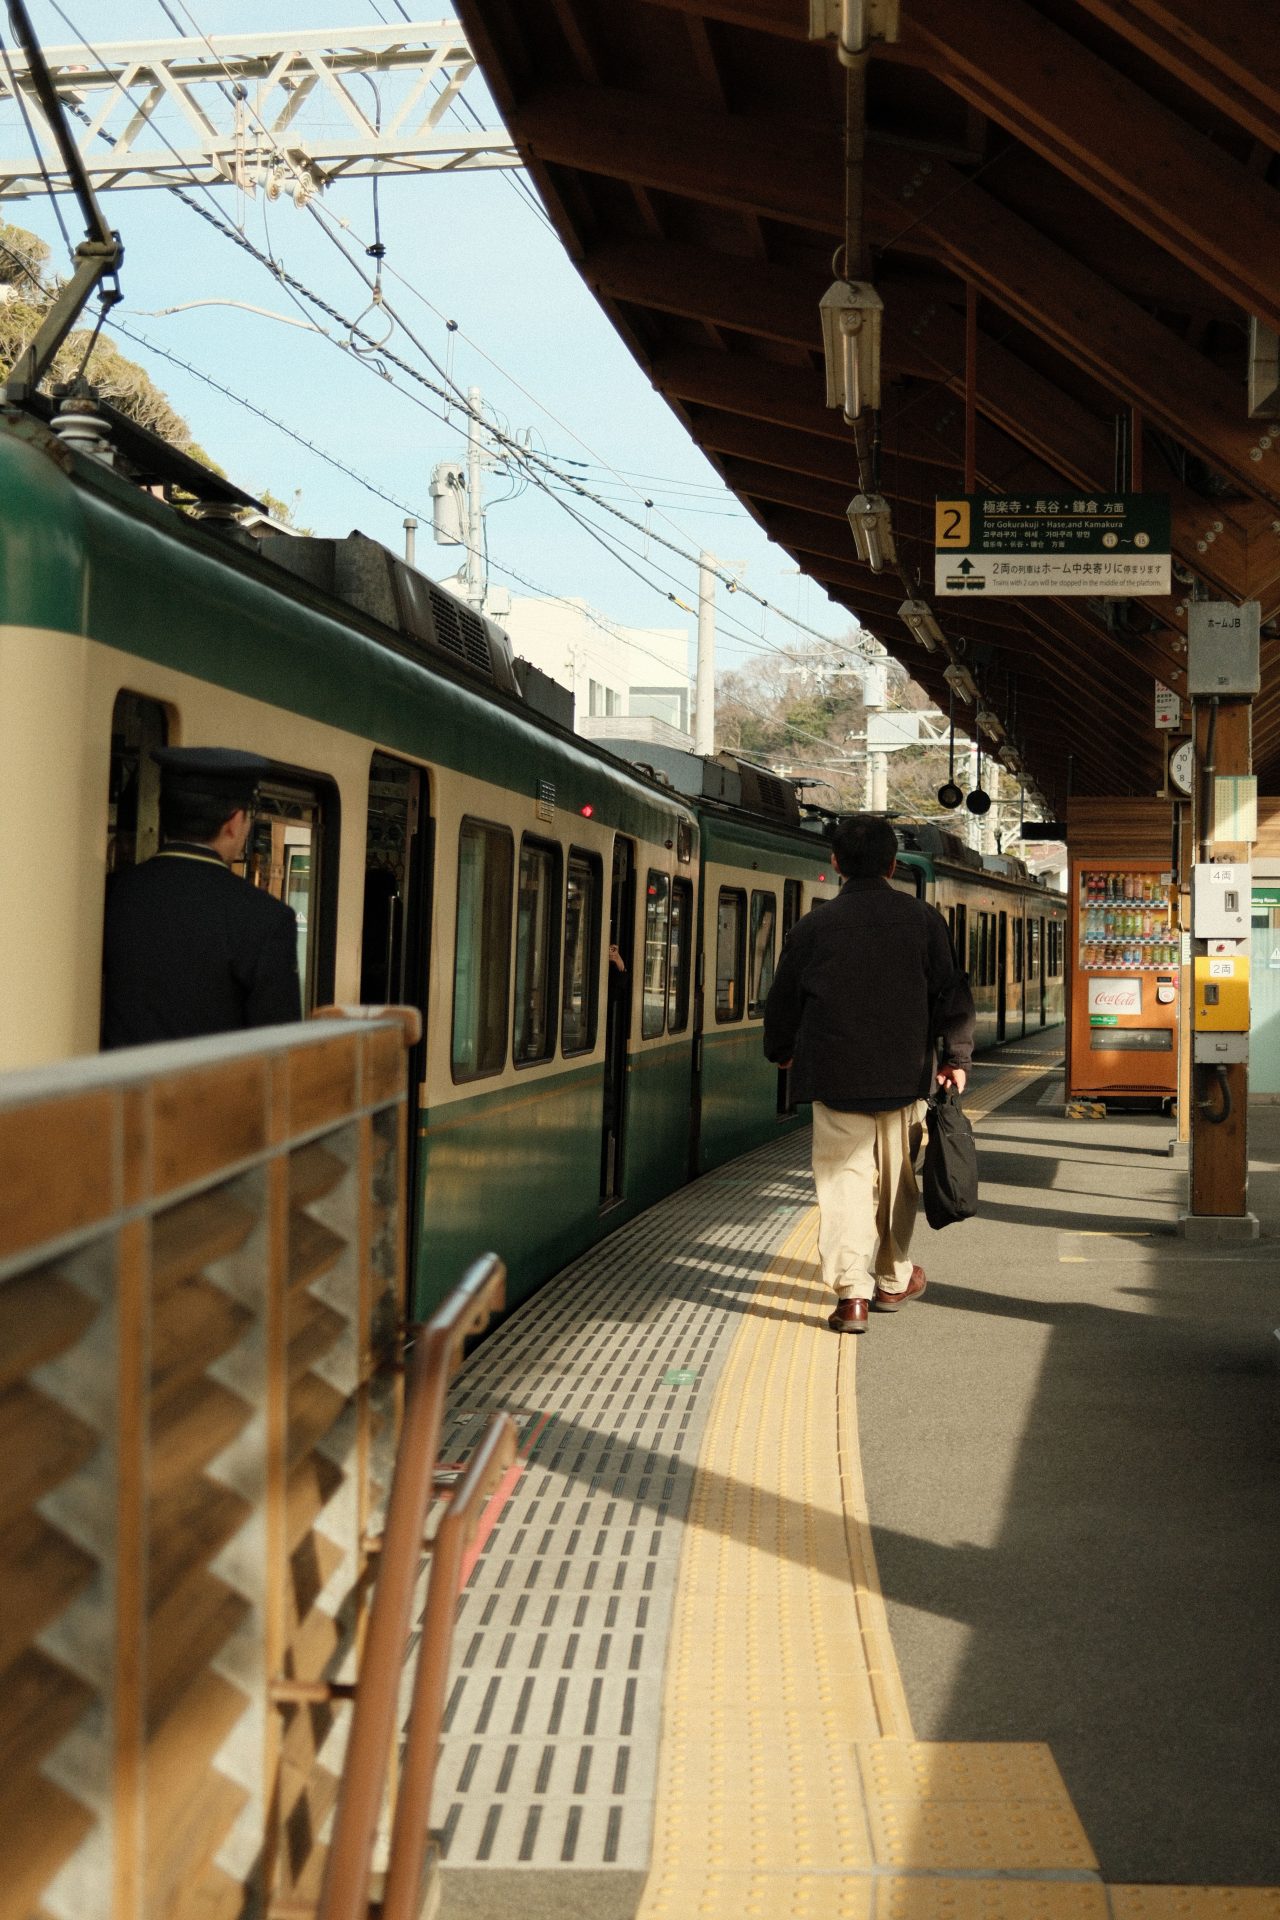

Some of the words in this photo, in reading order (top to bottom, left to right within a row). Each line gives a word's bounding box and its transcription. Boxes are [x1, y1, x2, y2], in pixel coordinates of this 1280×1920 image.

[983, 500, 1098, 514] 極楽寺・長谷・鎌倉
[1103, 502, 1124, 514] 方面
[943, 509, 961, 539] 2
[984, 521, 995, 529] for
[997, 521, 1039, 531] Gokurakuji
[1084, 521, 1123, 529] Kamakura
[992, 562, 1162, 575] 2両の列車はホーム中央寄りに停まります
[1208, 619, 1241, 628] ホームJB
[1179, 754, 1188, 762] 10
[1176, 764, 1182, 772] 9
[1213, 870, 1232, 881] 4両
[1213, 964, 1231, 975] 2両
